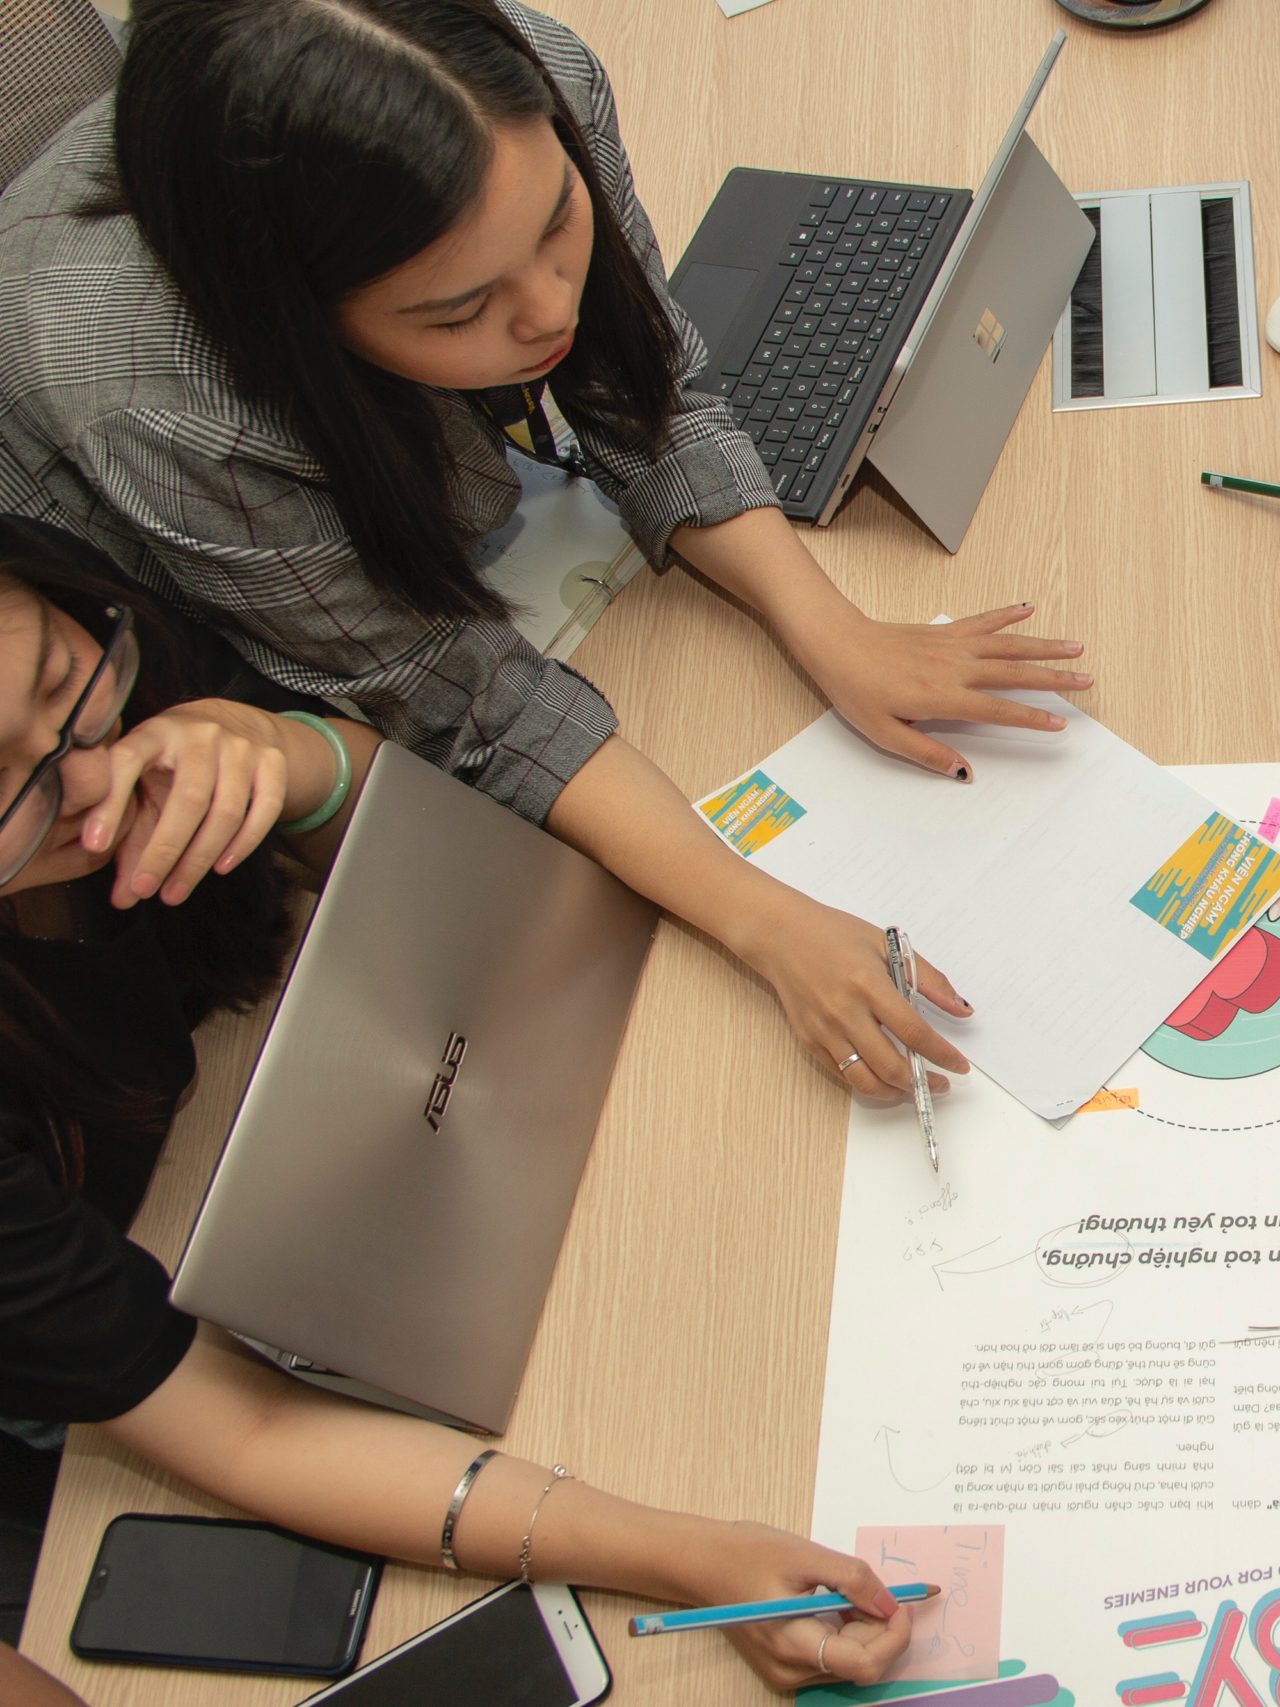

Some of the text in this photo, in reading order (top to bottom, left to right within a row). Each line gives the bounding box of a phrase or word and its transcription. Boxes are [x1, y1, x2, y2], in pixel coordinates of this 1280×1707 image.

[1204, 856, 1255, 923] VIÊN NGẬM
[424, 1032, 468, 1135] ASUS
[1078, 1212, 1166, 1235] thương!
[1172, 1211, 1215, 1233] yêu
[1220, 1214, 1257, 1235] toả
[1042, 1247, 1131, 1270] chướng,
[1138, 1244, 1217, 1267] nghiệp
[1223, 1248, 1261, 1269] toả
[1000, 1344, 1021, 1353] hoa
[1052, 1375, 1085, 1387] mong
[1091, 1379, 1106, 1388] tui
[1082, 1398, 1098, 1407] vui
[1057, 1414, 1084, 1424] gom
[1176, 1441, 1215, 1453] nghen.
[967, 1482, 994, 1492] xong
[1027, 1483, 1039, 1492] ta
[1158, 1481, 1188, 1491] haha,
[1196, 1500, 1214, 1510] khi
[1184, 1572, 1233, 1597] YOUR
[1238, 1565, 1273, 1587] FOR
[1103, 1584, 1180, 1611] ENEMIES
